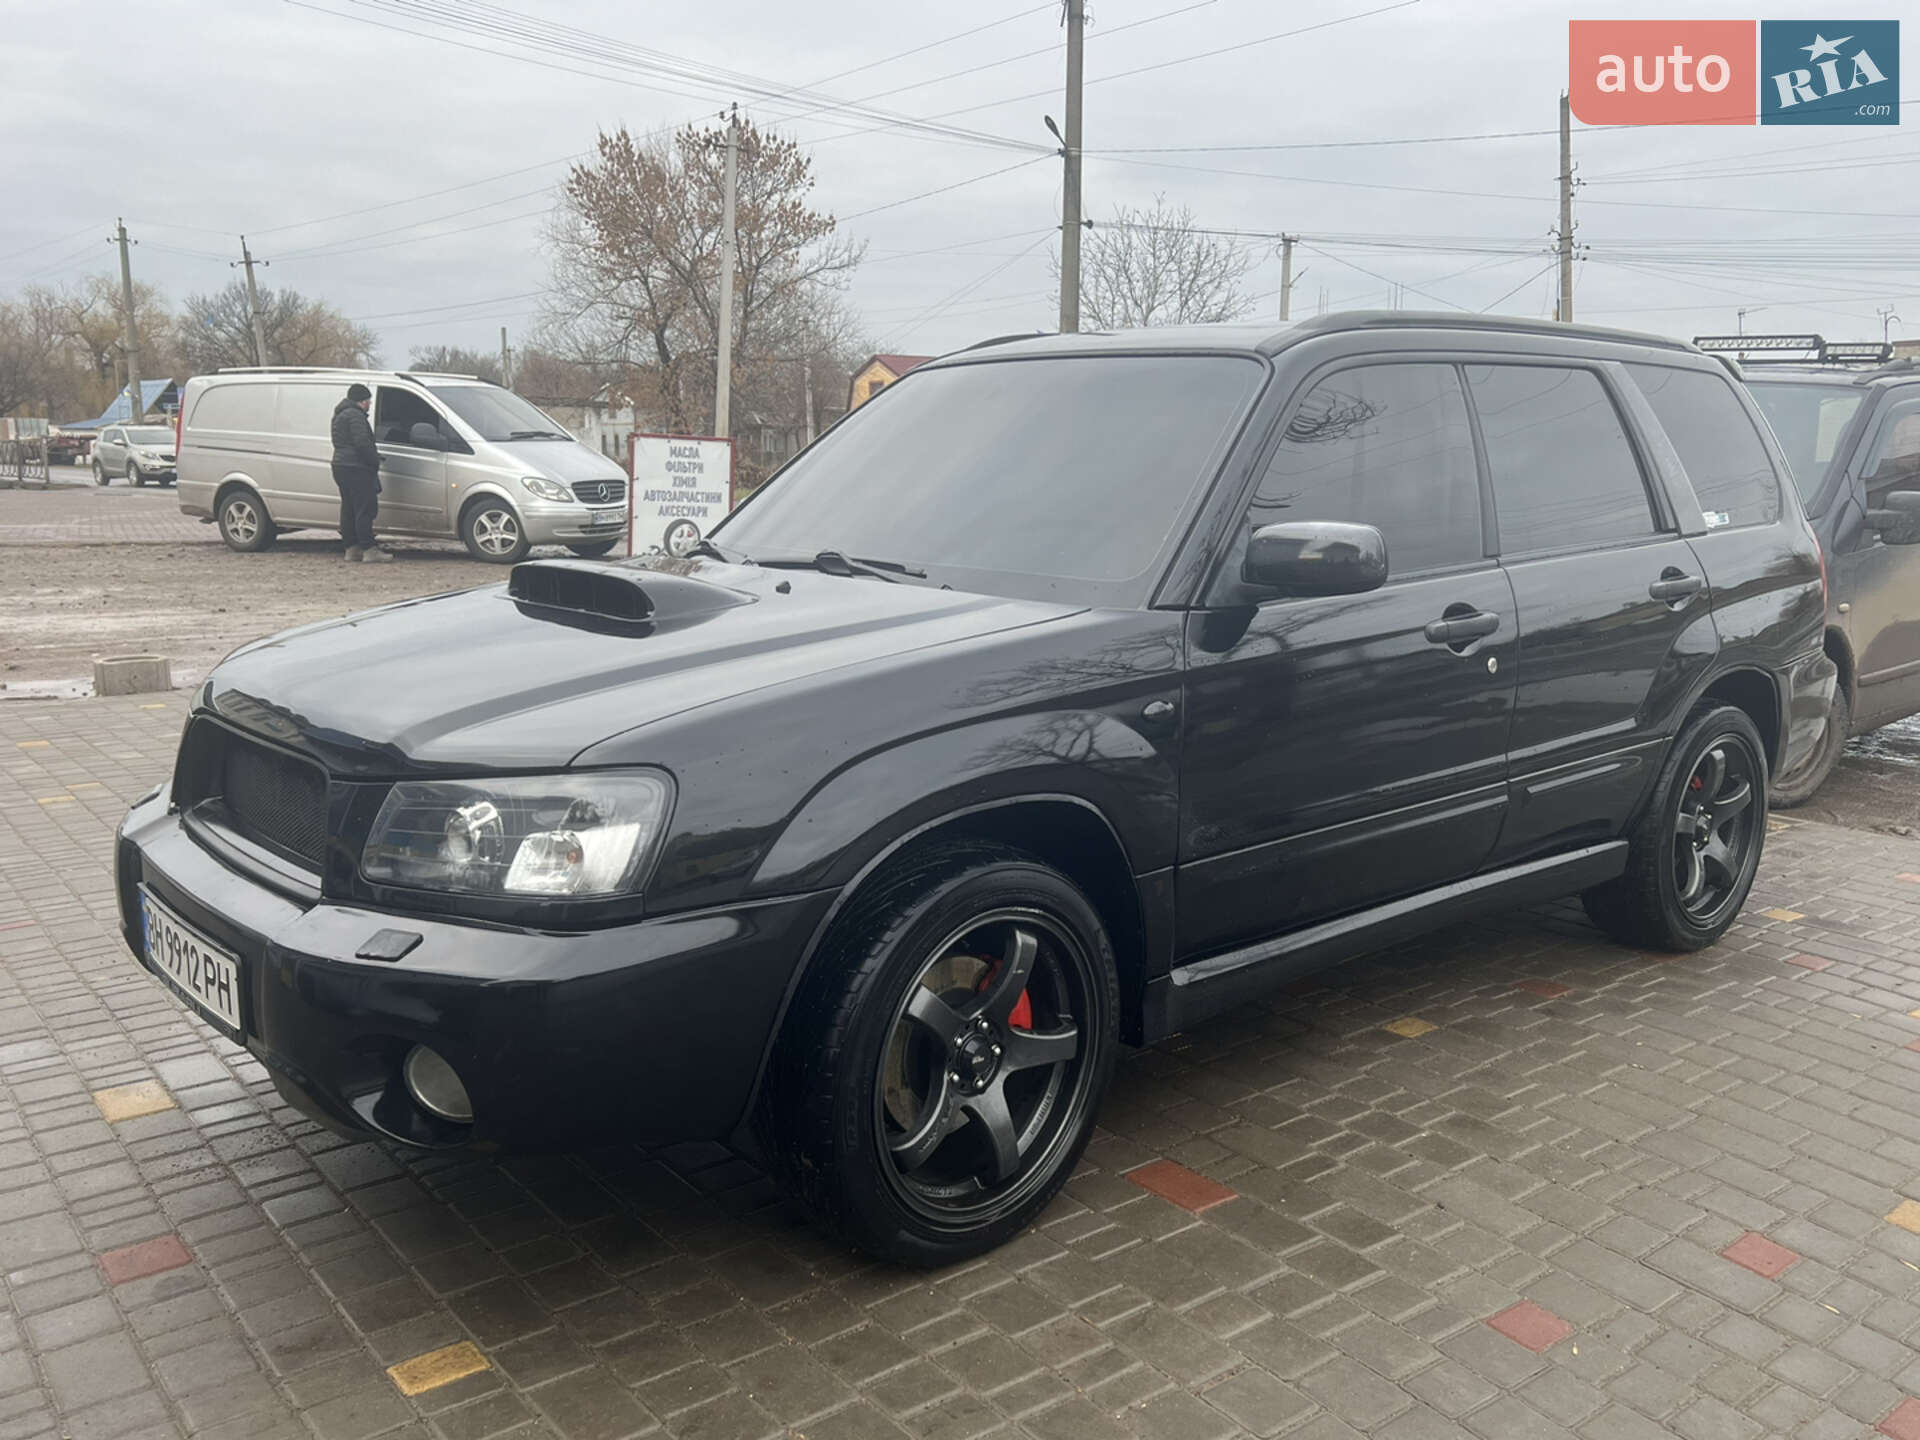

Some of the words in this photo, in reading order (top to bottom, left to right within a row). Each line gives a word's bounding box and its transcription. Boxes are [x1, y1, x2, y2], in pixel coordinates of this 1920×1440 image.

[668, 446, 700, 459] МАСЛА
[665, 461, 704, 474] ФІЛЬТРИ
[643, 489, 722, 504] АВТОЗАПЧАСТИНИ
[658, 505, 708, 518] АКСЕСУАРИ
